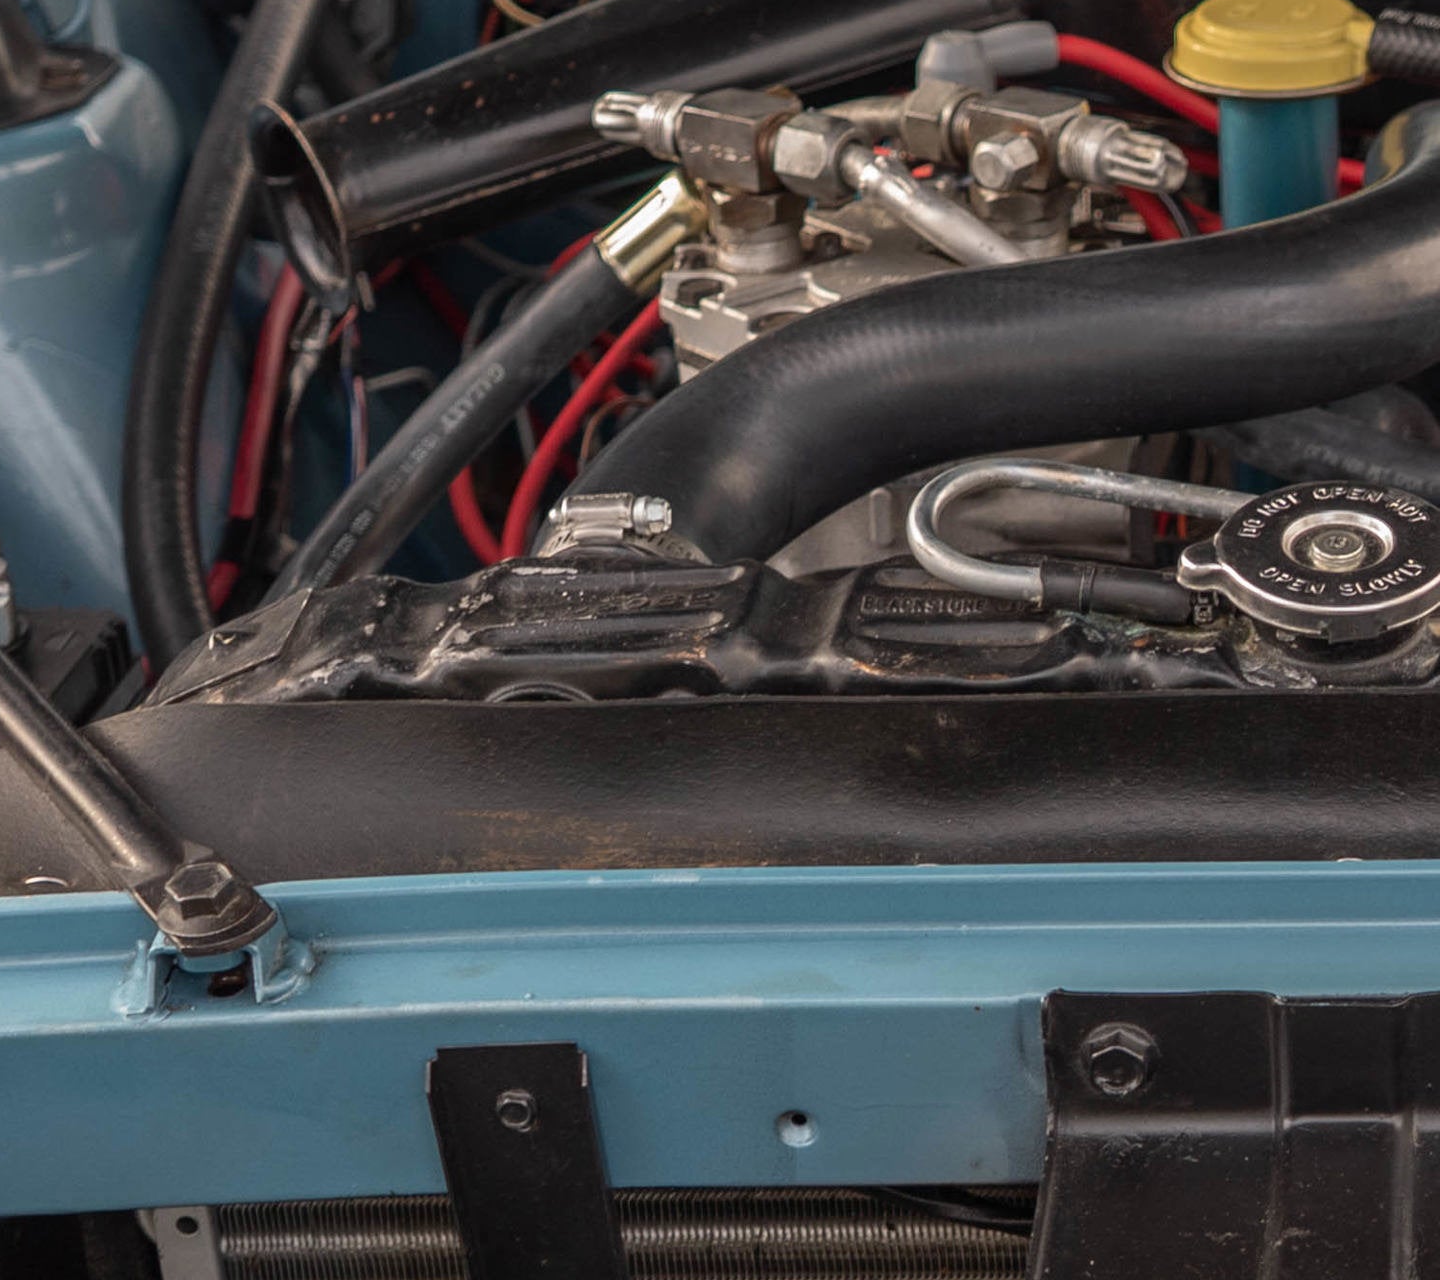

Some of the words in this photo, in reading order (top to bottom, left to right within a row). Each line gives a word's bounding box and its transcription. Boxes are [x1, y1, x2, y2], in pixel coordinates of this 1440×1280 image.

[1238, 518, 1266, 538] DO
[1257, 491, 1302, 517] NOT
[1312, 487, 1385, 504] OPEN
[1386, 497, 1431, 524] HOT
[1259, 567, 1326, 595] OPEN
[1339, 558, 1426, 597] SLOWLY
